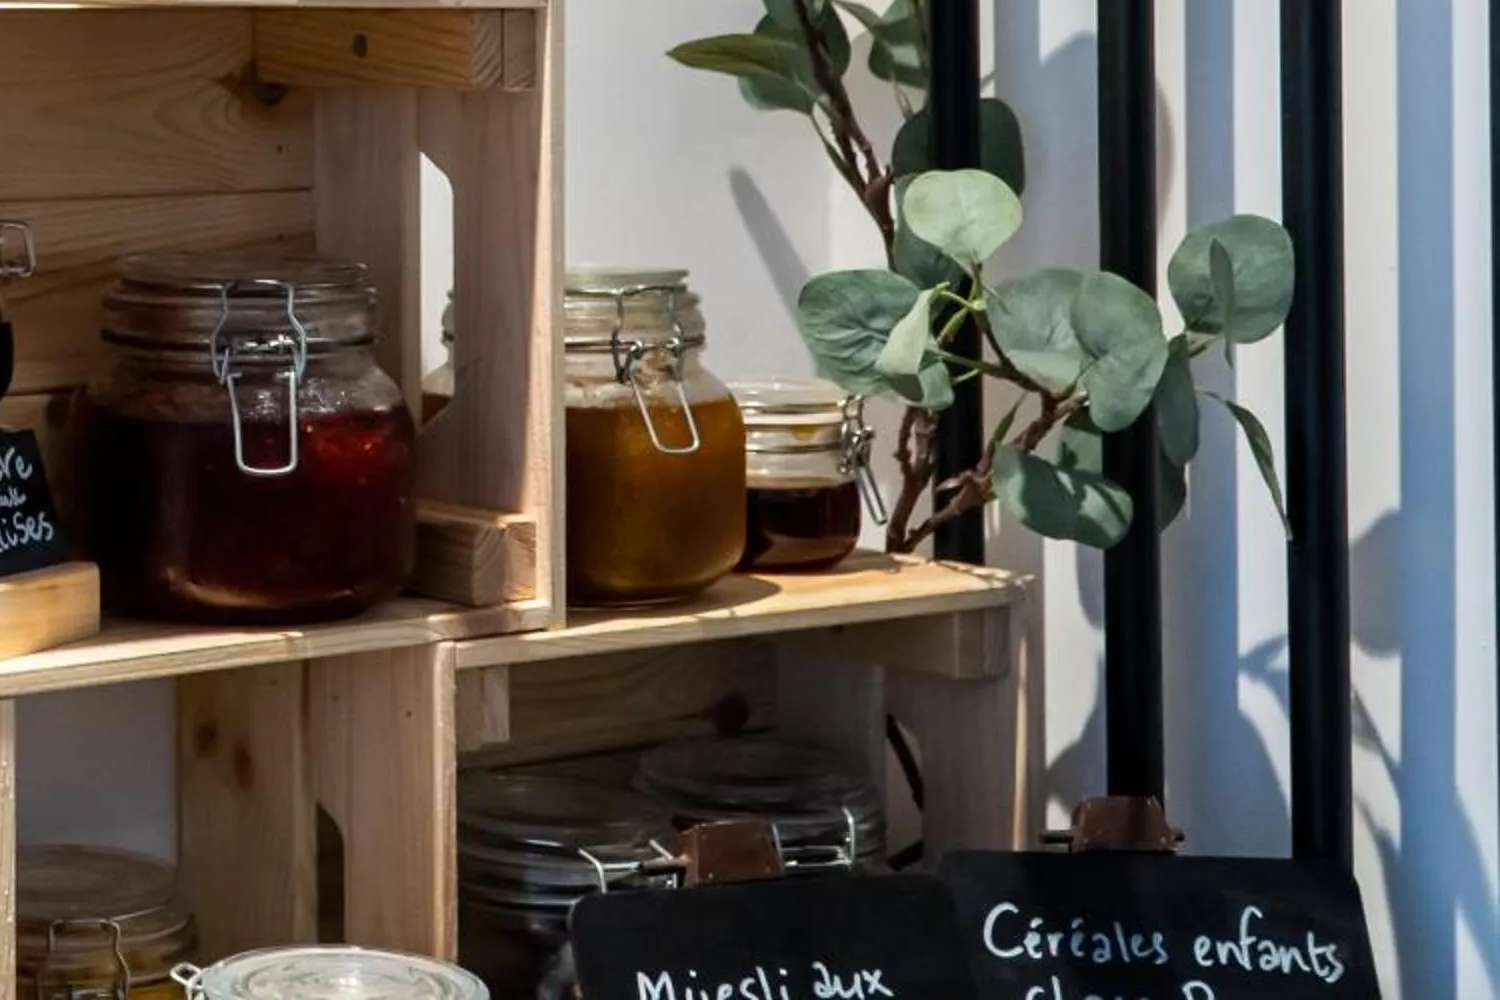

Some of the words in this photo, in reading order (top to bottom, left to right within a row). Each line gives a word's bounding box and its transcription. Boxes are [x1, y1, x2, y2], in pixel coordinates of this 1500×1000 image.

[983, 901, 1169, 965] Céréales
[1194, 905, 1345, 984] enfants
[812, 960, 895, 1000] aux
